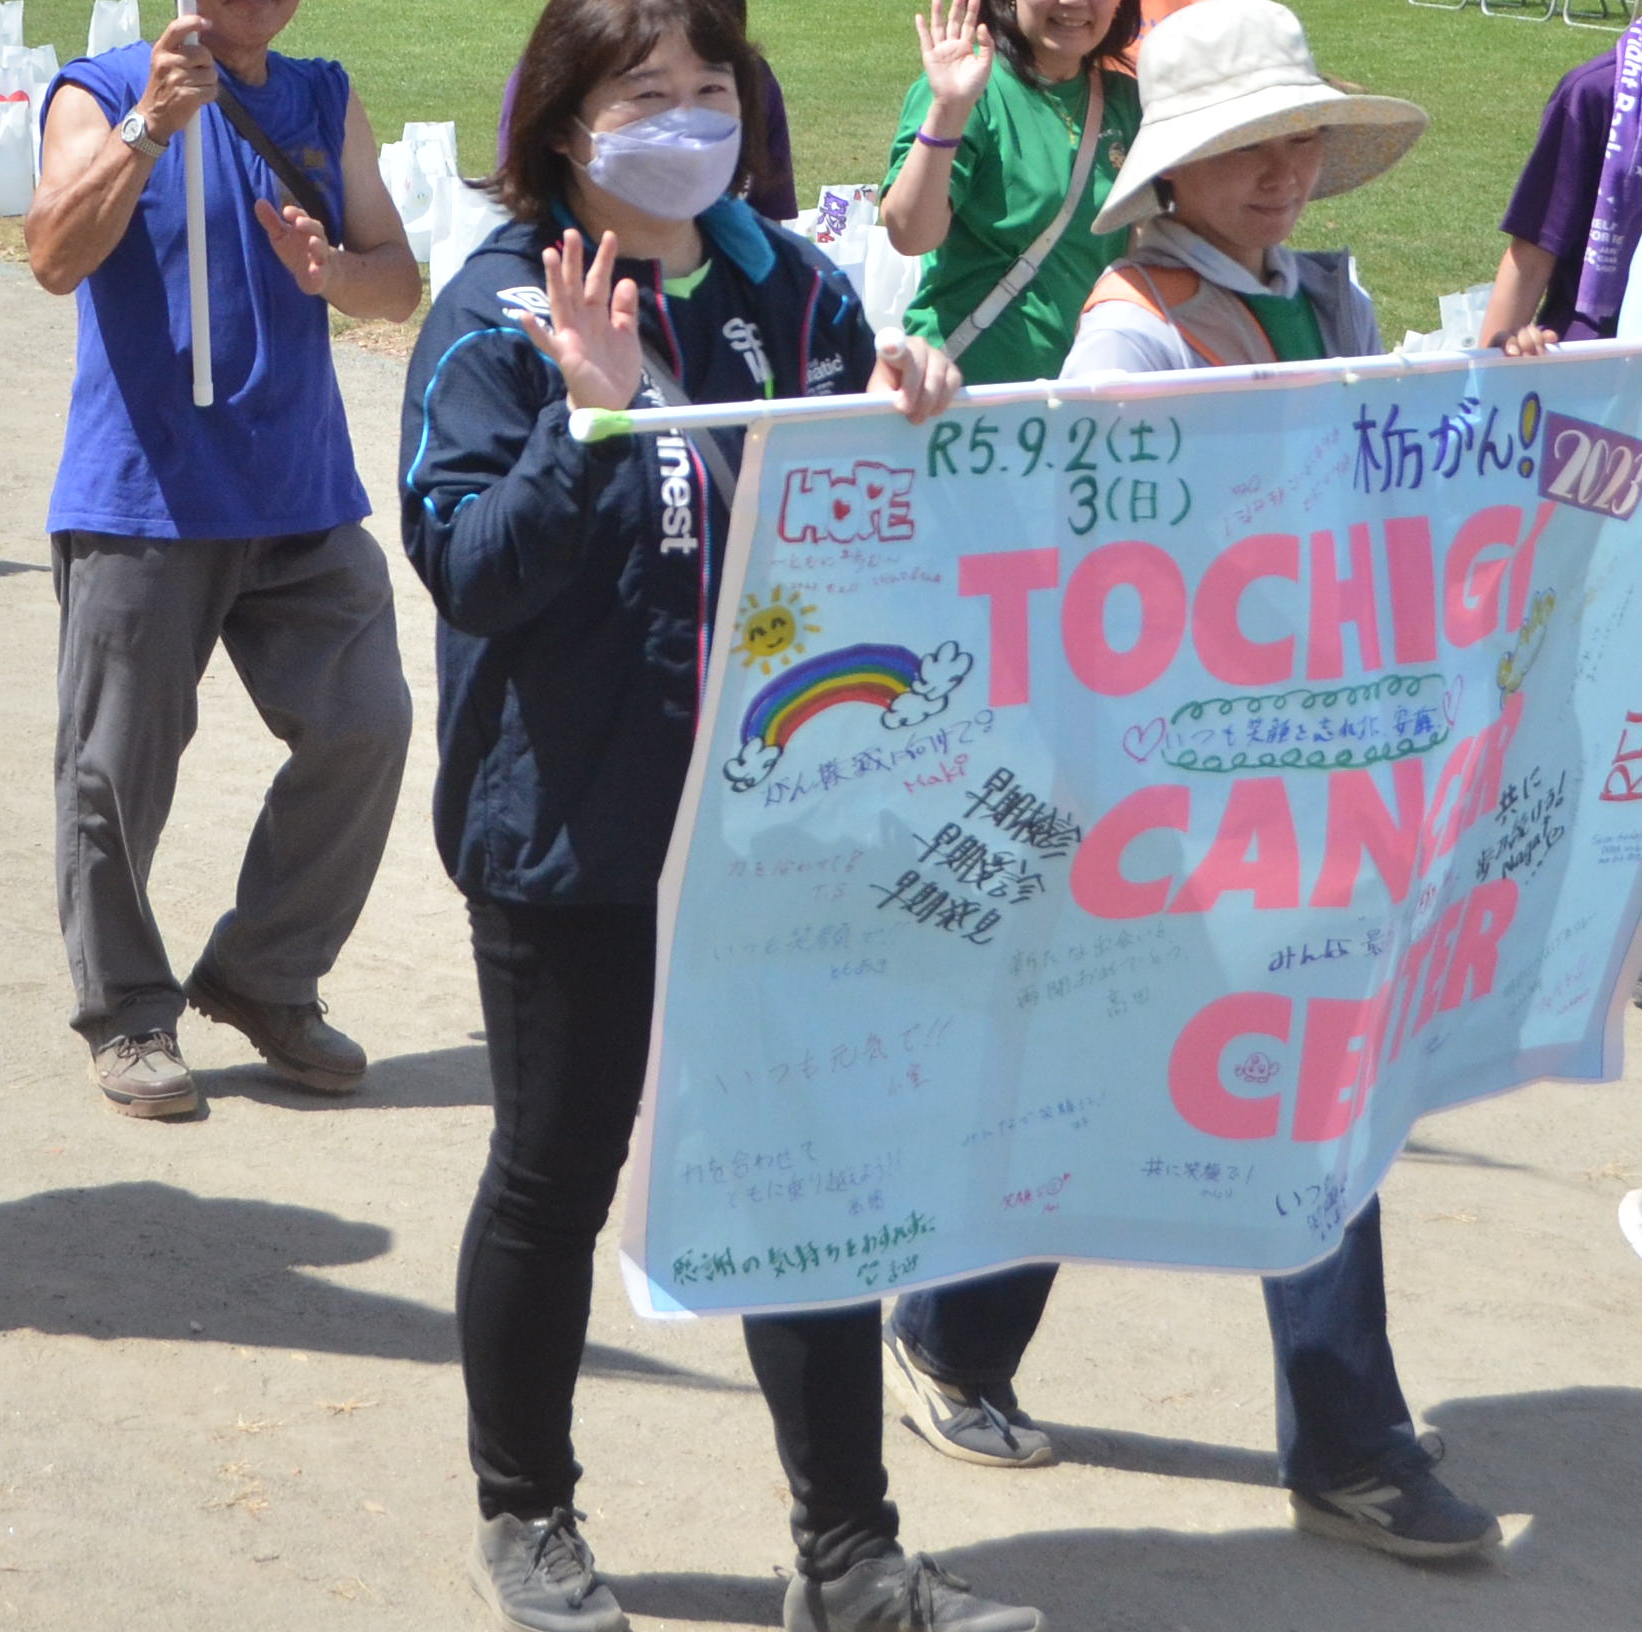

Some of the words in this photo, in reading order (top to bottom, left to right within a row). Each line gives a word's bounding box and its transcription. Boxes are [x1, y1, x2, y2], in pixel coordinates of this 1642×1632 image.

[777, 459, 917, 544] HOPE
[957, 500, 1557, 709] TOCHIGI
[1167, 876, 1519, 1144] CETER
